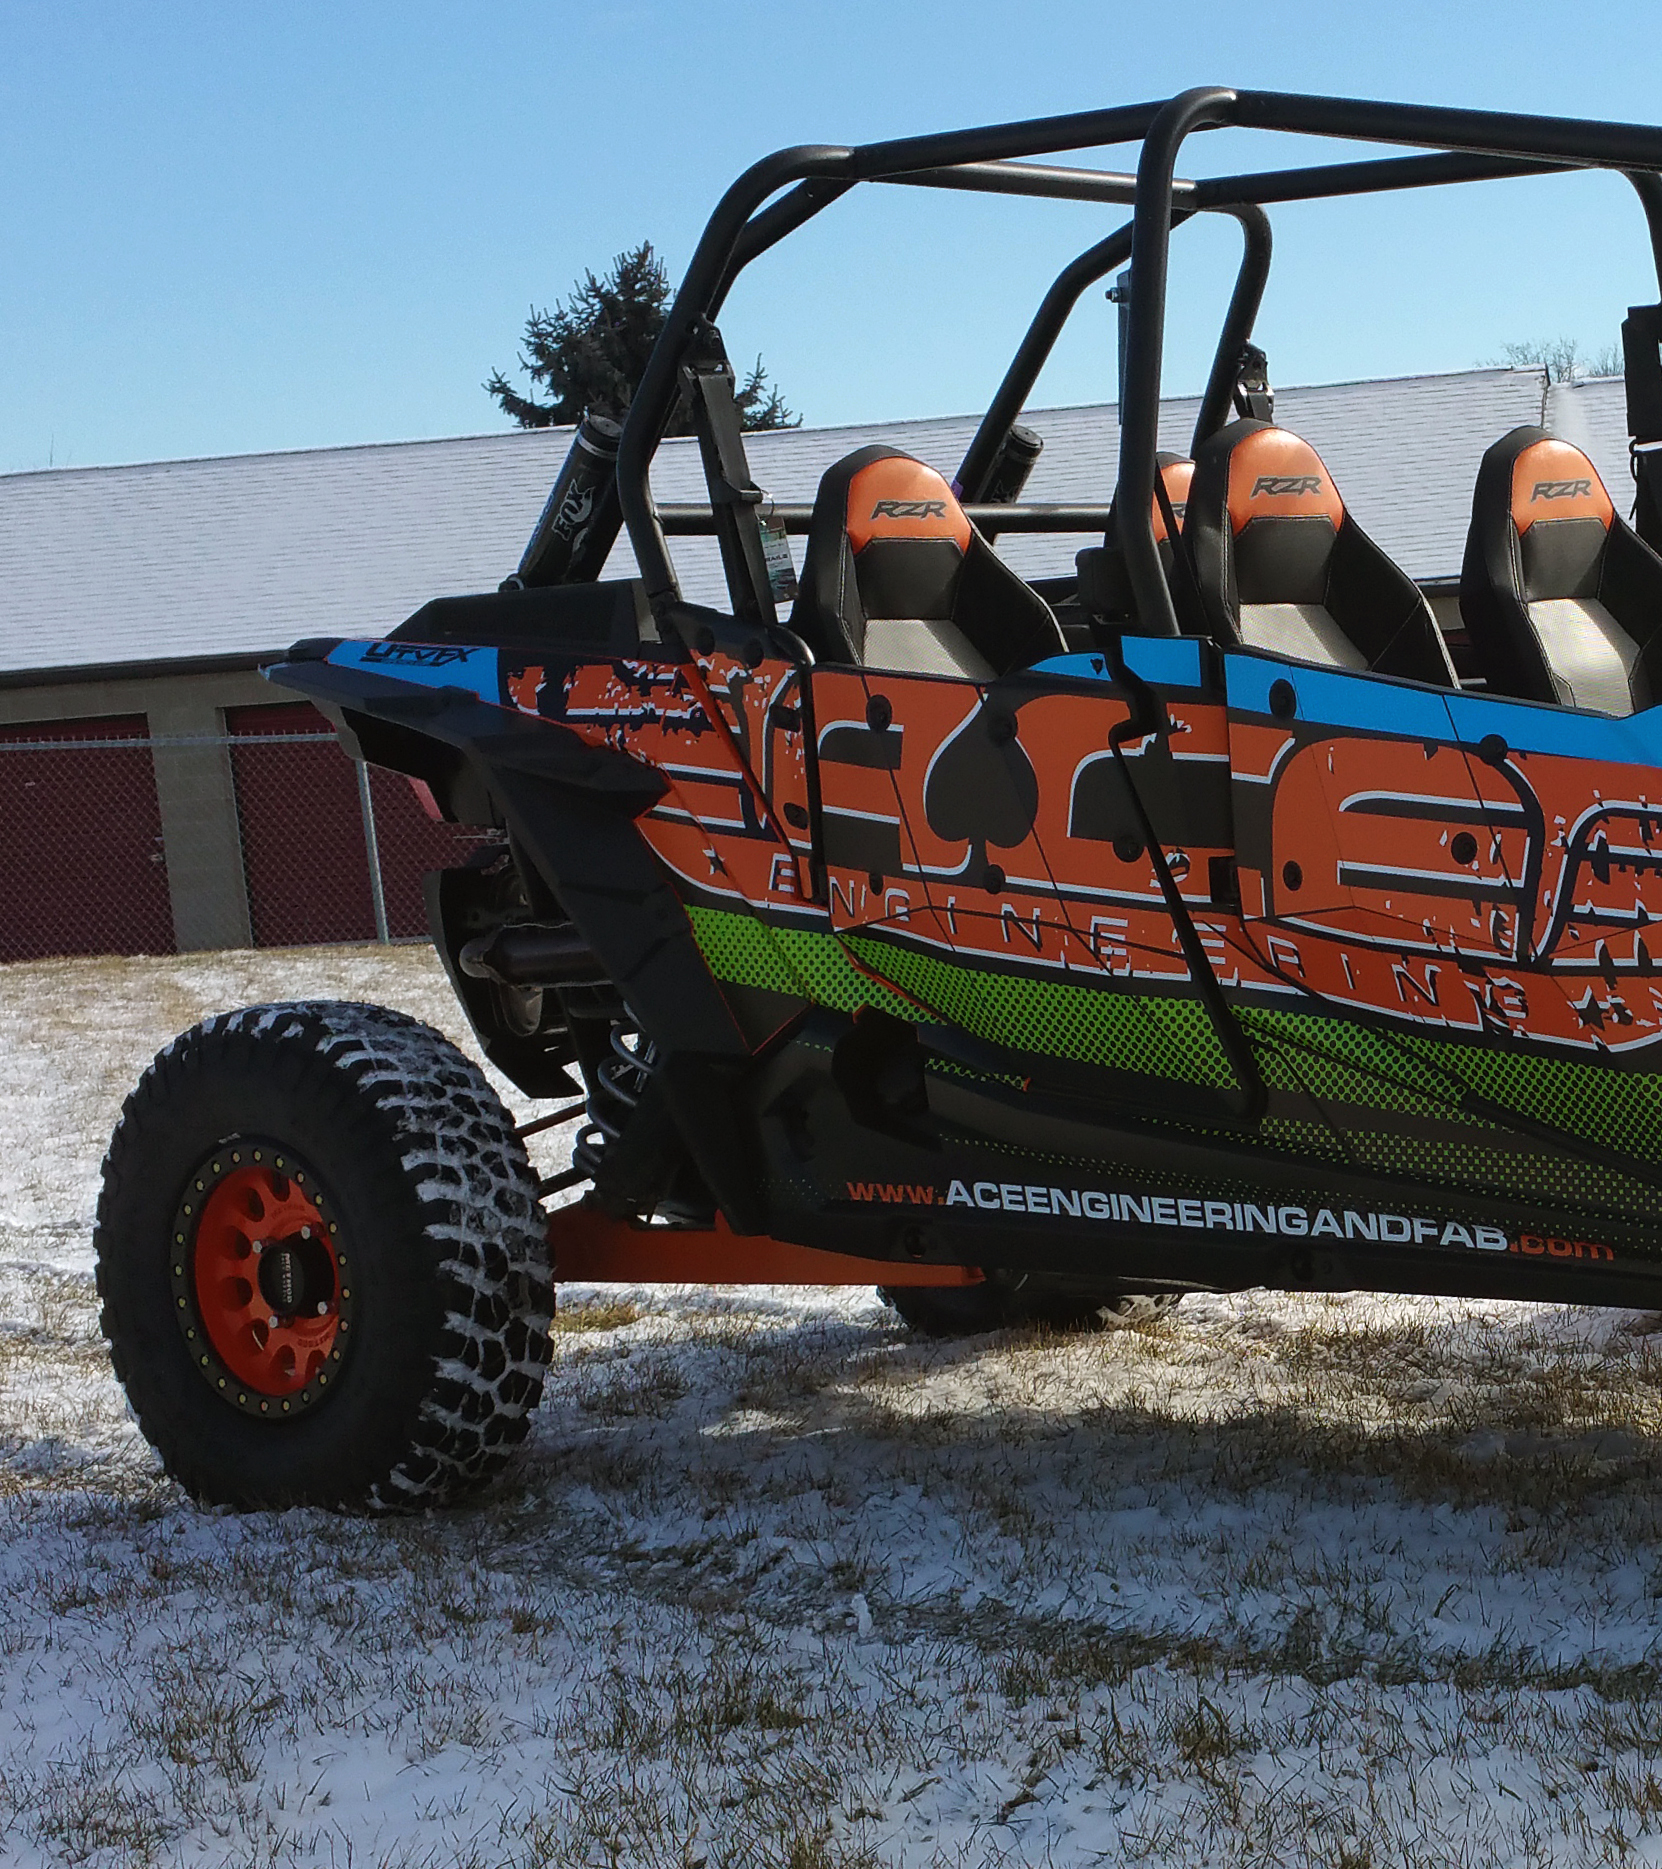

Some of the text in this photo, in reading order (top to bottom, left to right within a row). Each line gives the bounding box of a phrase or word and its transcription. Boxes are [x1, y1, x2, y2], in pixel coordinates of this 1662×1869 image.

[1250, 475, 1322, 500] RZR
[1529, 478, 1593, 505] RZR
[551, 478, 596, 542] FOX
[869, 499, 947, 521] RZR
[846, 1179, 1614, 1262] www.ACEENGINEERINGANDFAB.com
